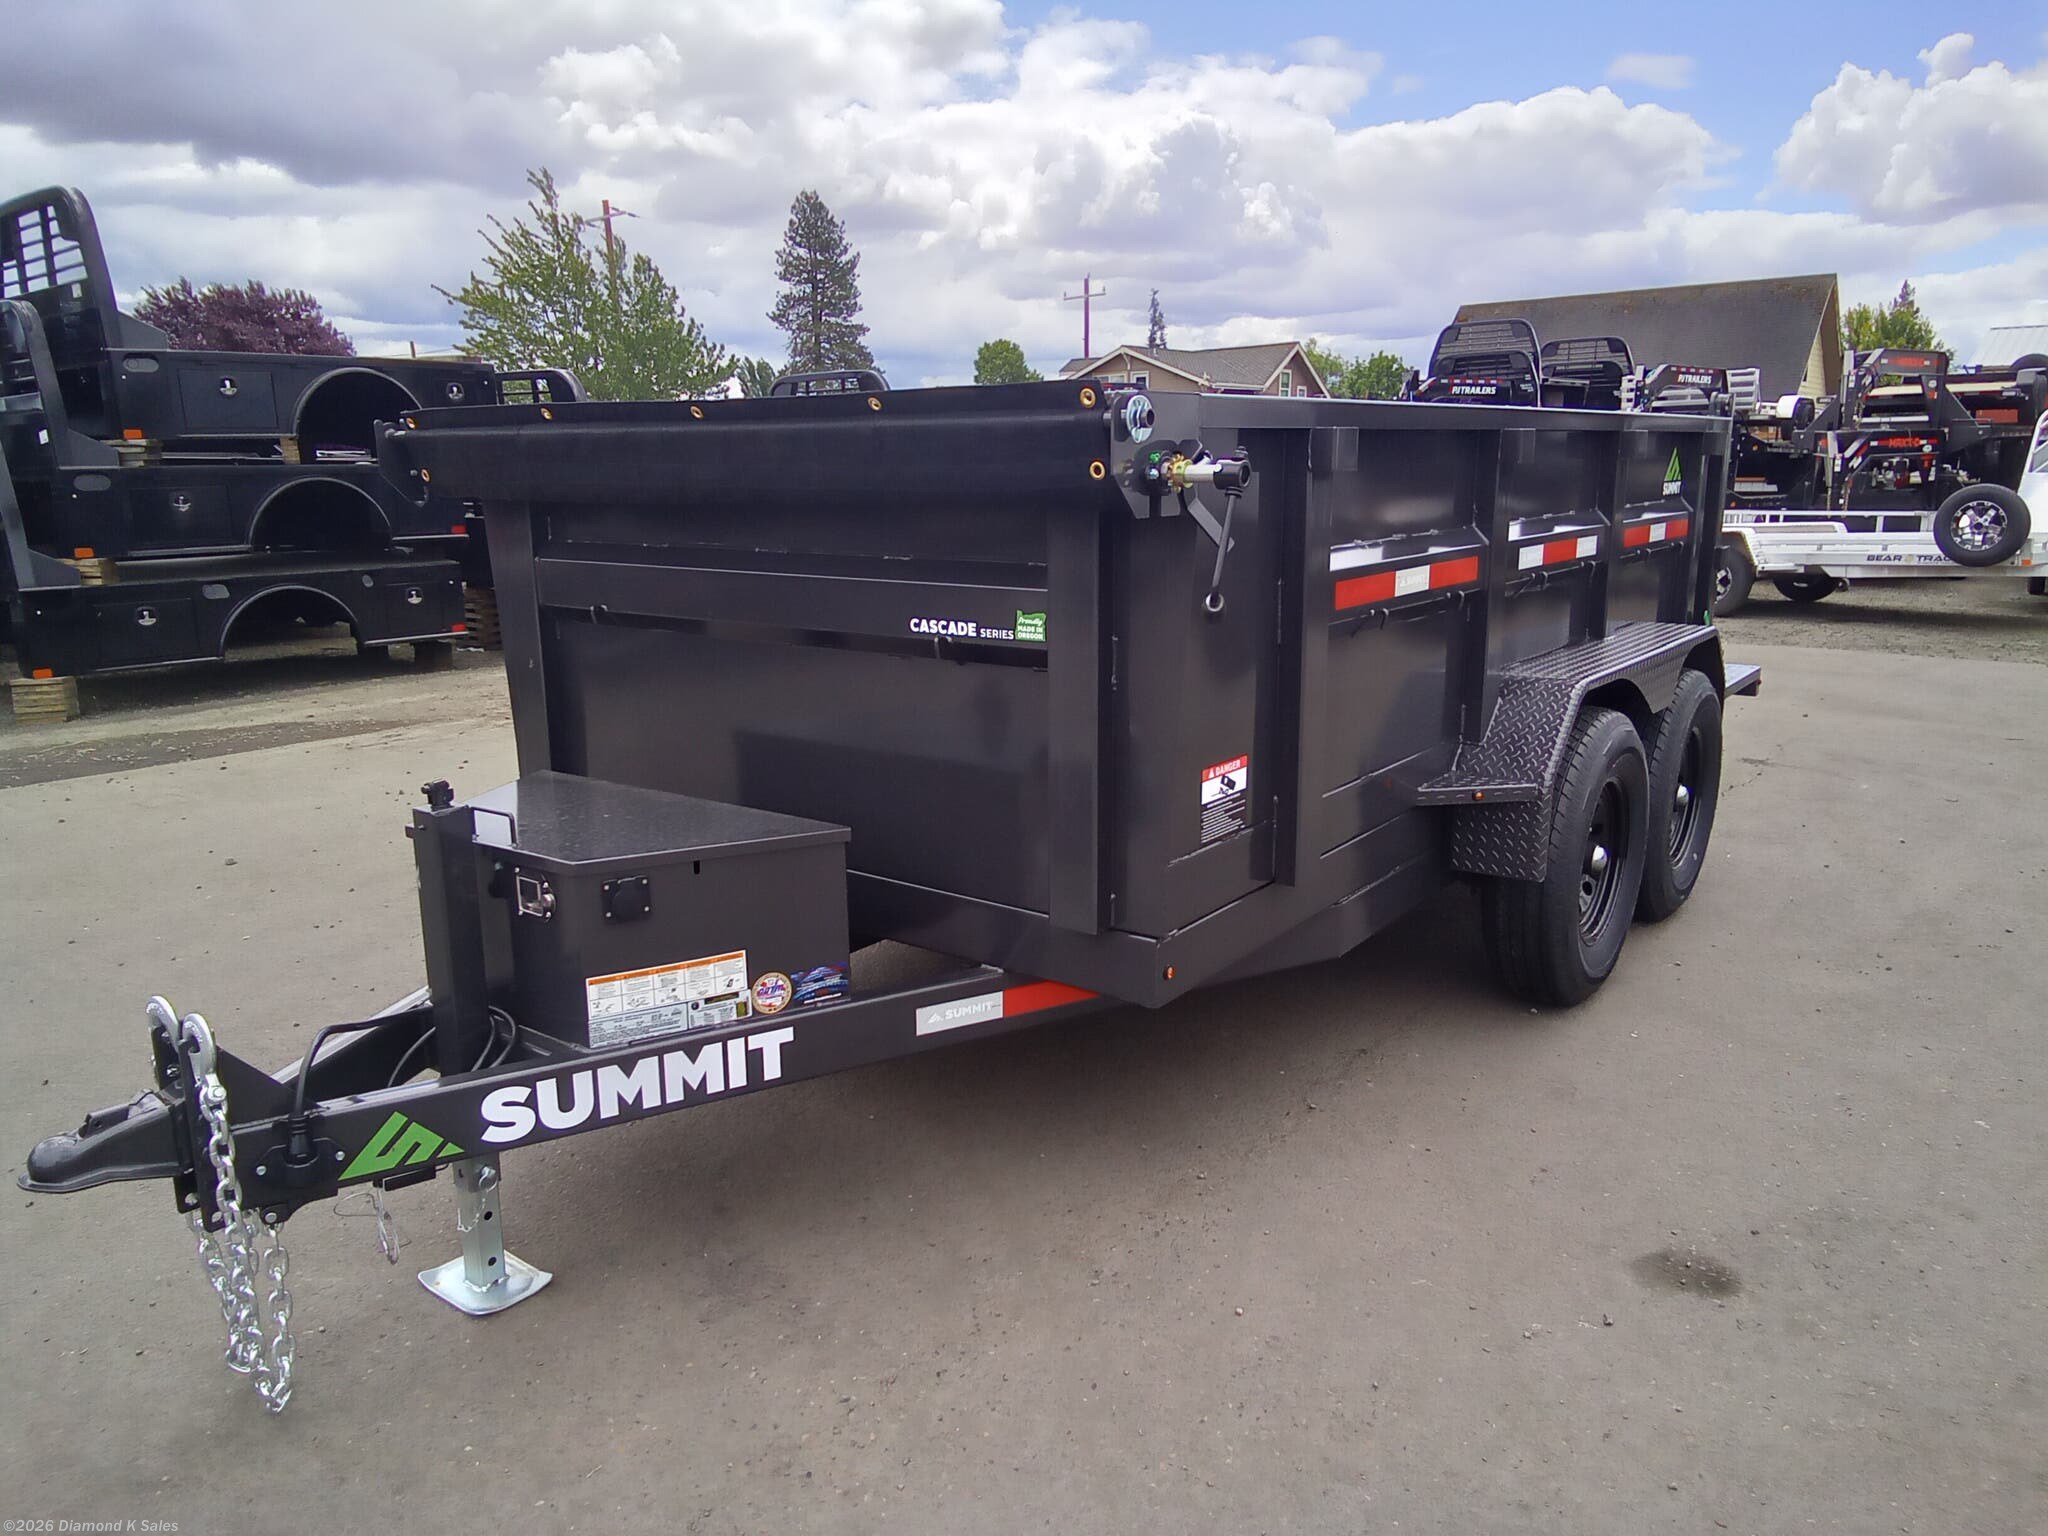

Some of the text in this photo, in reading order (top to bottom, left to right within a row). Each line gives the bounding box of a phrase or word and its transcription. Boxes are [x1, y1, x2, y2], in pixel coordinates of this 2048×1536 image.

[1866, 554, 1903, 562] BEAR
[909, 618, 1014, 640] CASCADE SERIES
[1017, 625, 1035, 633] MADE
[1017, 631, 1044, 640] OREGON
[1215, 759, 1241, 776] DANGER
[944, 1001, 993, 1020] SUMMIT
[480, 1026, 795, 1143] SUMMIT
